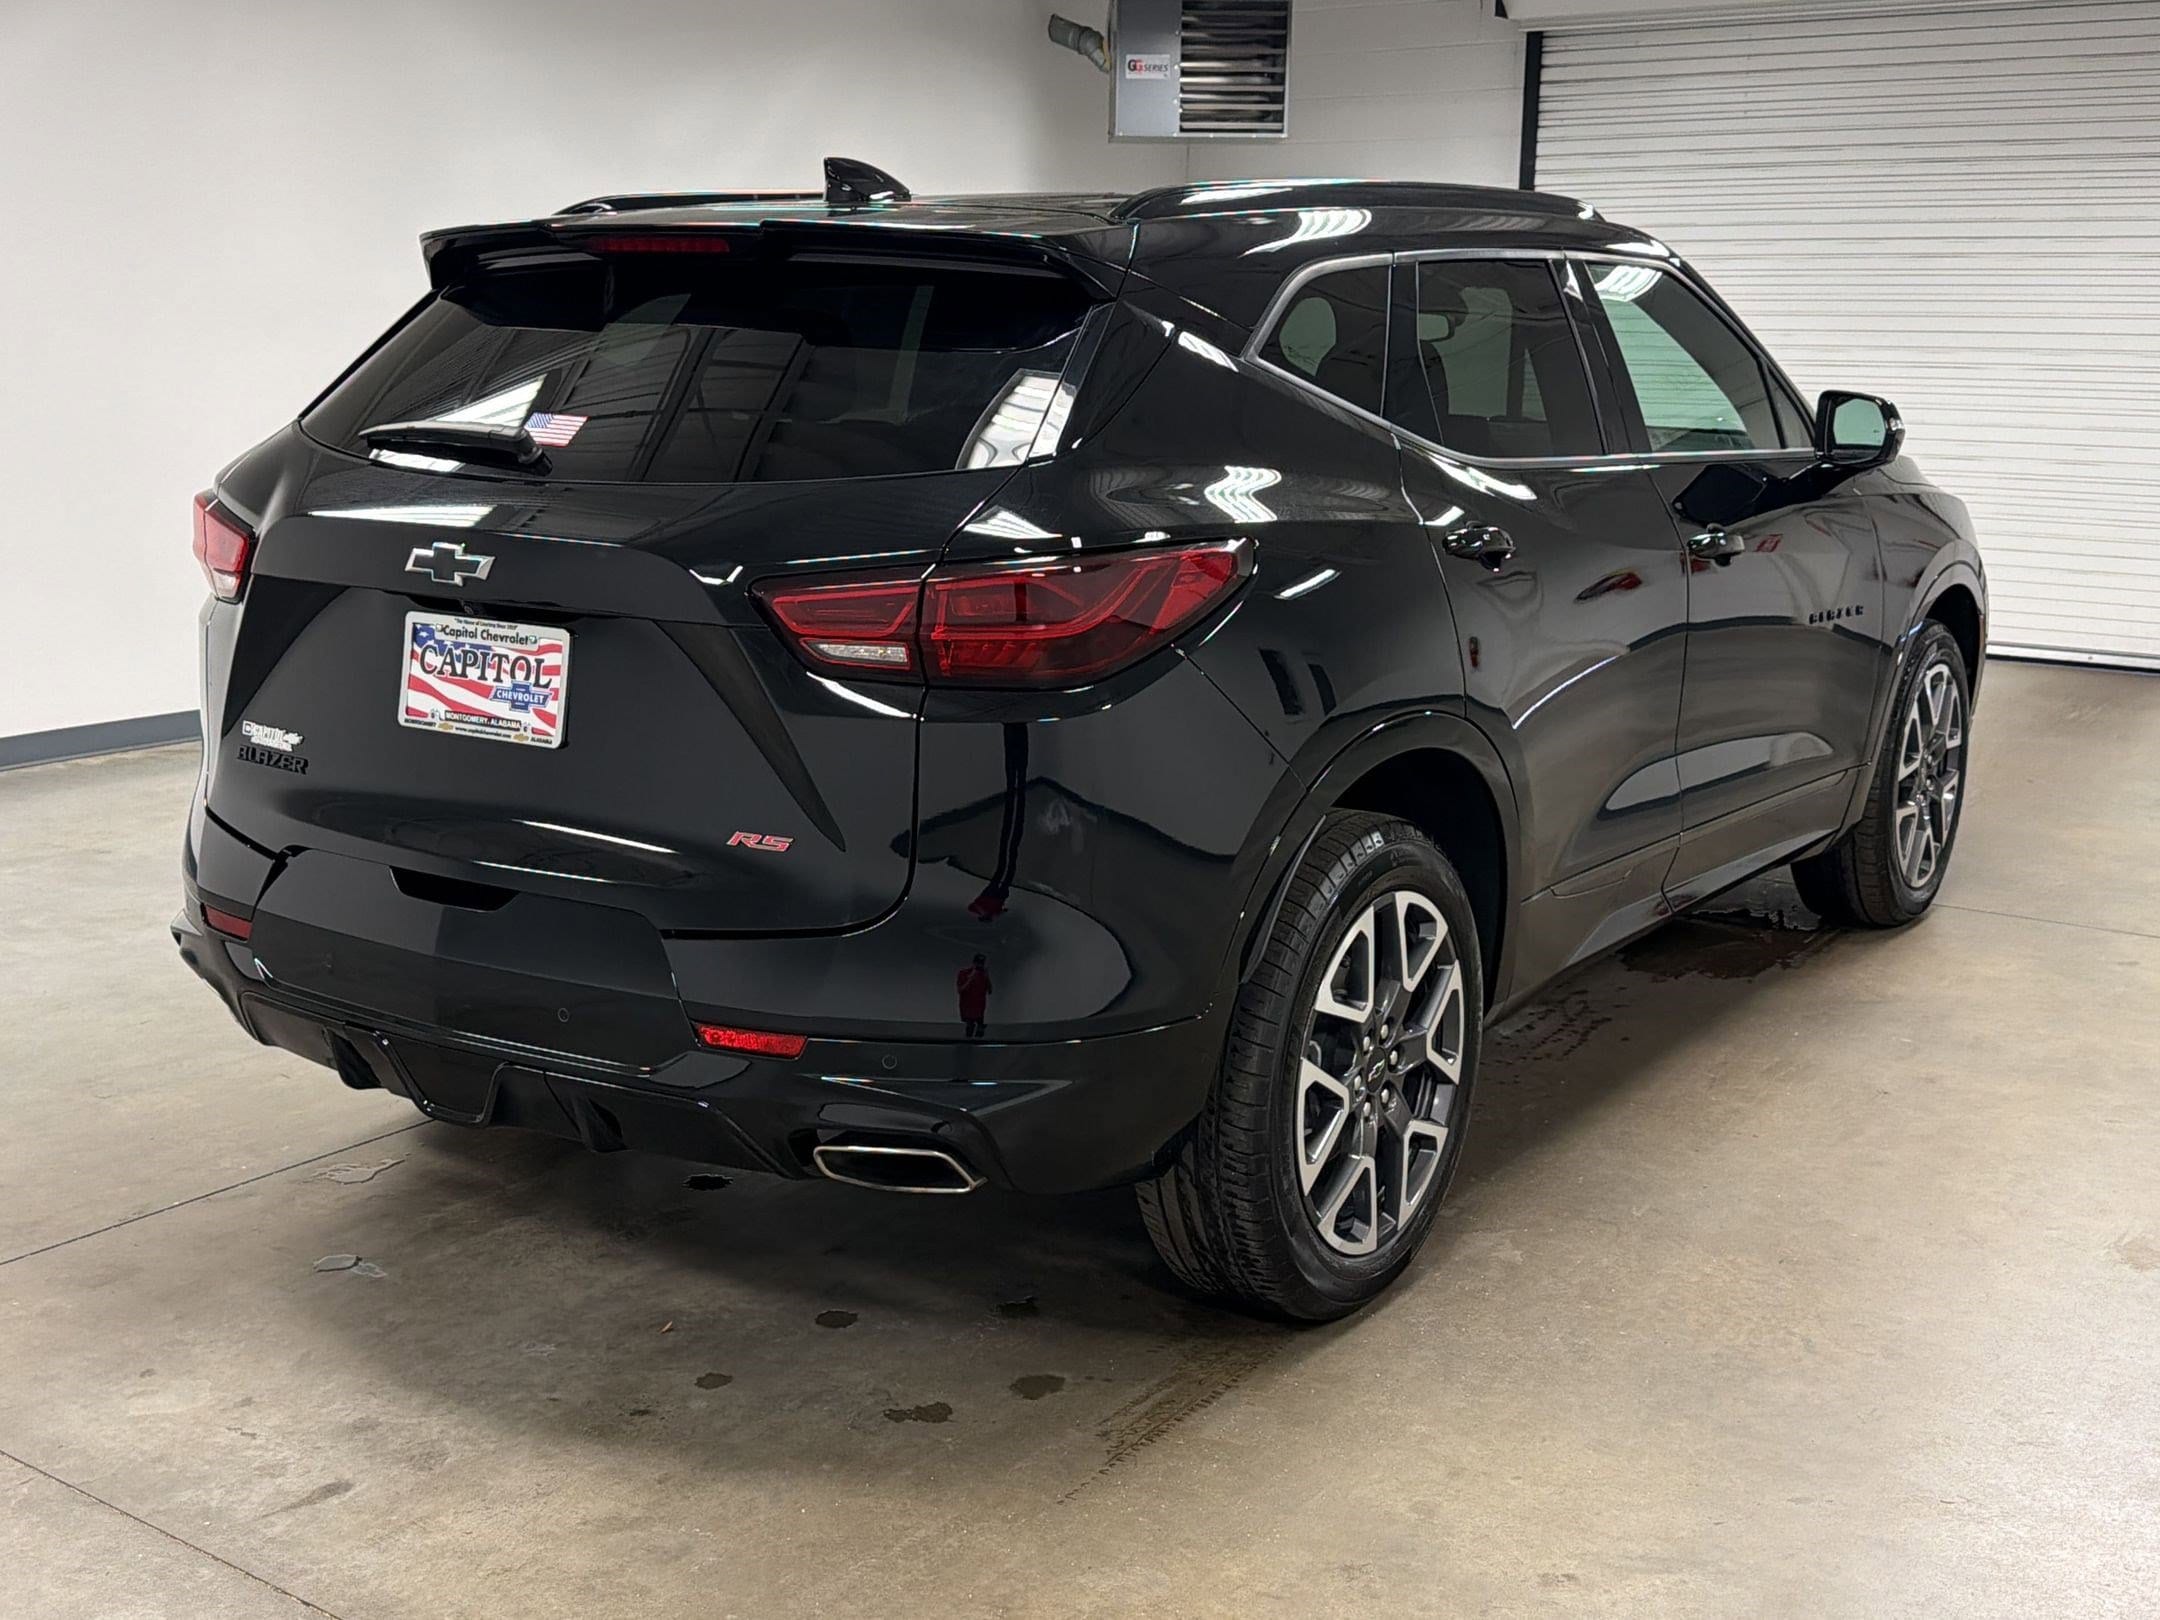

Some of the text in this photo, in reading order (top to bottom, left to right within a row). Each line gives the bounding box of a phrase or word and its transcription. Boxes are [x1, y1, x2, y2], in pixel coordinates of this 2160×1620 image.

[1144, 64, 1168, 72] SERIES
[444, 624, 529, 645] Capitol Chevrolet
[420, 645, 553, 689] CAPITOL
[496, 690, 545, 704] CHEVROLET
[490, 715, 522, 729] ALABAMA
[237, 745, 309, 775] BLAZER
[726, 831, 794, 852] RS
